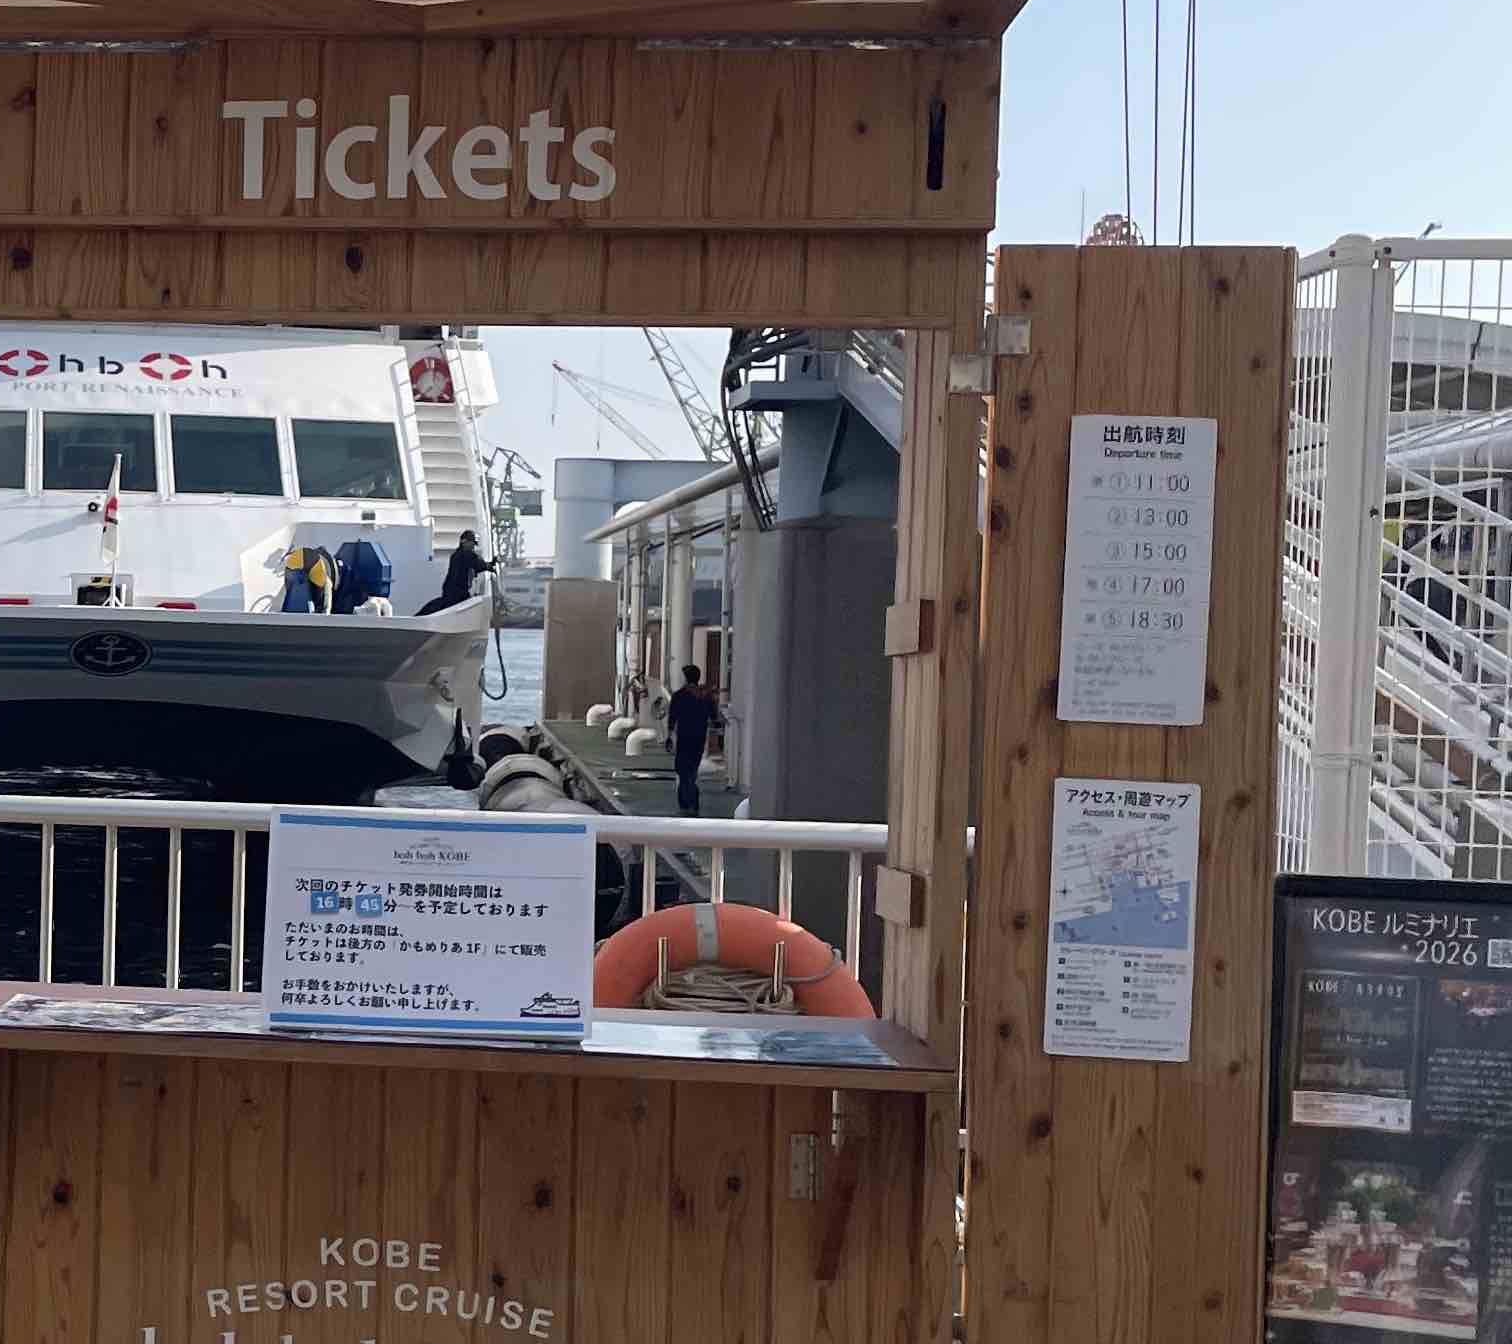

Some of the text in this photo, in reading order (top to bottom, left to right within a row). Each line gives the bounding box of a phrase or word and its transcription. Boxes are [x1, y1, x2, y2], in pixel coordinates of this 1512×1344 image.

[222, 93, 618, 203] Tickets
[13, 380, 68, 393] PORT
[1103, 425, 1186, 446] 出航時刻
[1104, 447, 1183, 460] Departure time
[1137, 473, 1190, 492] 11:00
[1136, 508, 1189, 528] 13:00
[1134, 542, 1187, 561] 15:00
[1132, 576, 1185, 595] 17:00
[1130, 609, 1184, 631] 18:30
[1082, 808, 1115, 817] Access
[295, 877, 504, 899] 次回のチケット発券開始時間は
[284, 921, 406, 938] ただいまのお時間は、
[1312, 907, 1480, 939] KOBE ルミナリエ
[284, 950, 366, 966] しております。
[1414, 939, 1479, 966] 2026
[281, 978, 456, 997] お手数をおかけいたしますが、
[281, 992, 481, 1012] 何卒よろしくお願い申し上げます。
[319, 1237, 443, 1272] KOBE
[205, 1279, 555, 1339] RESORT CRUISE
